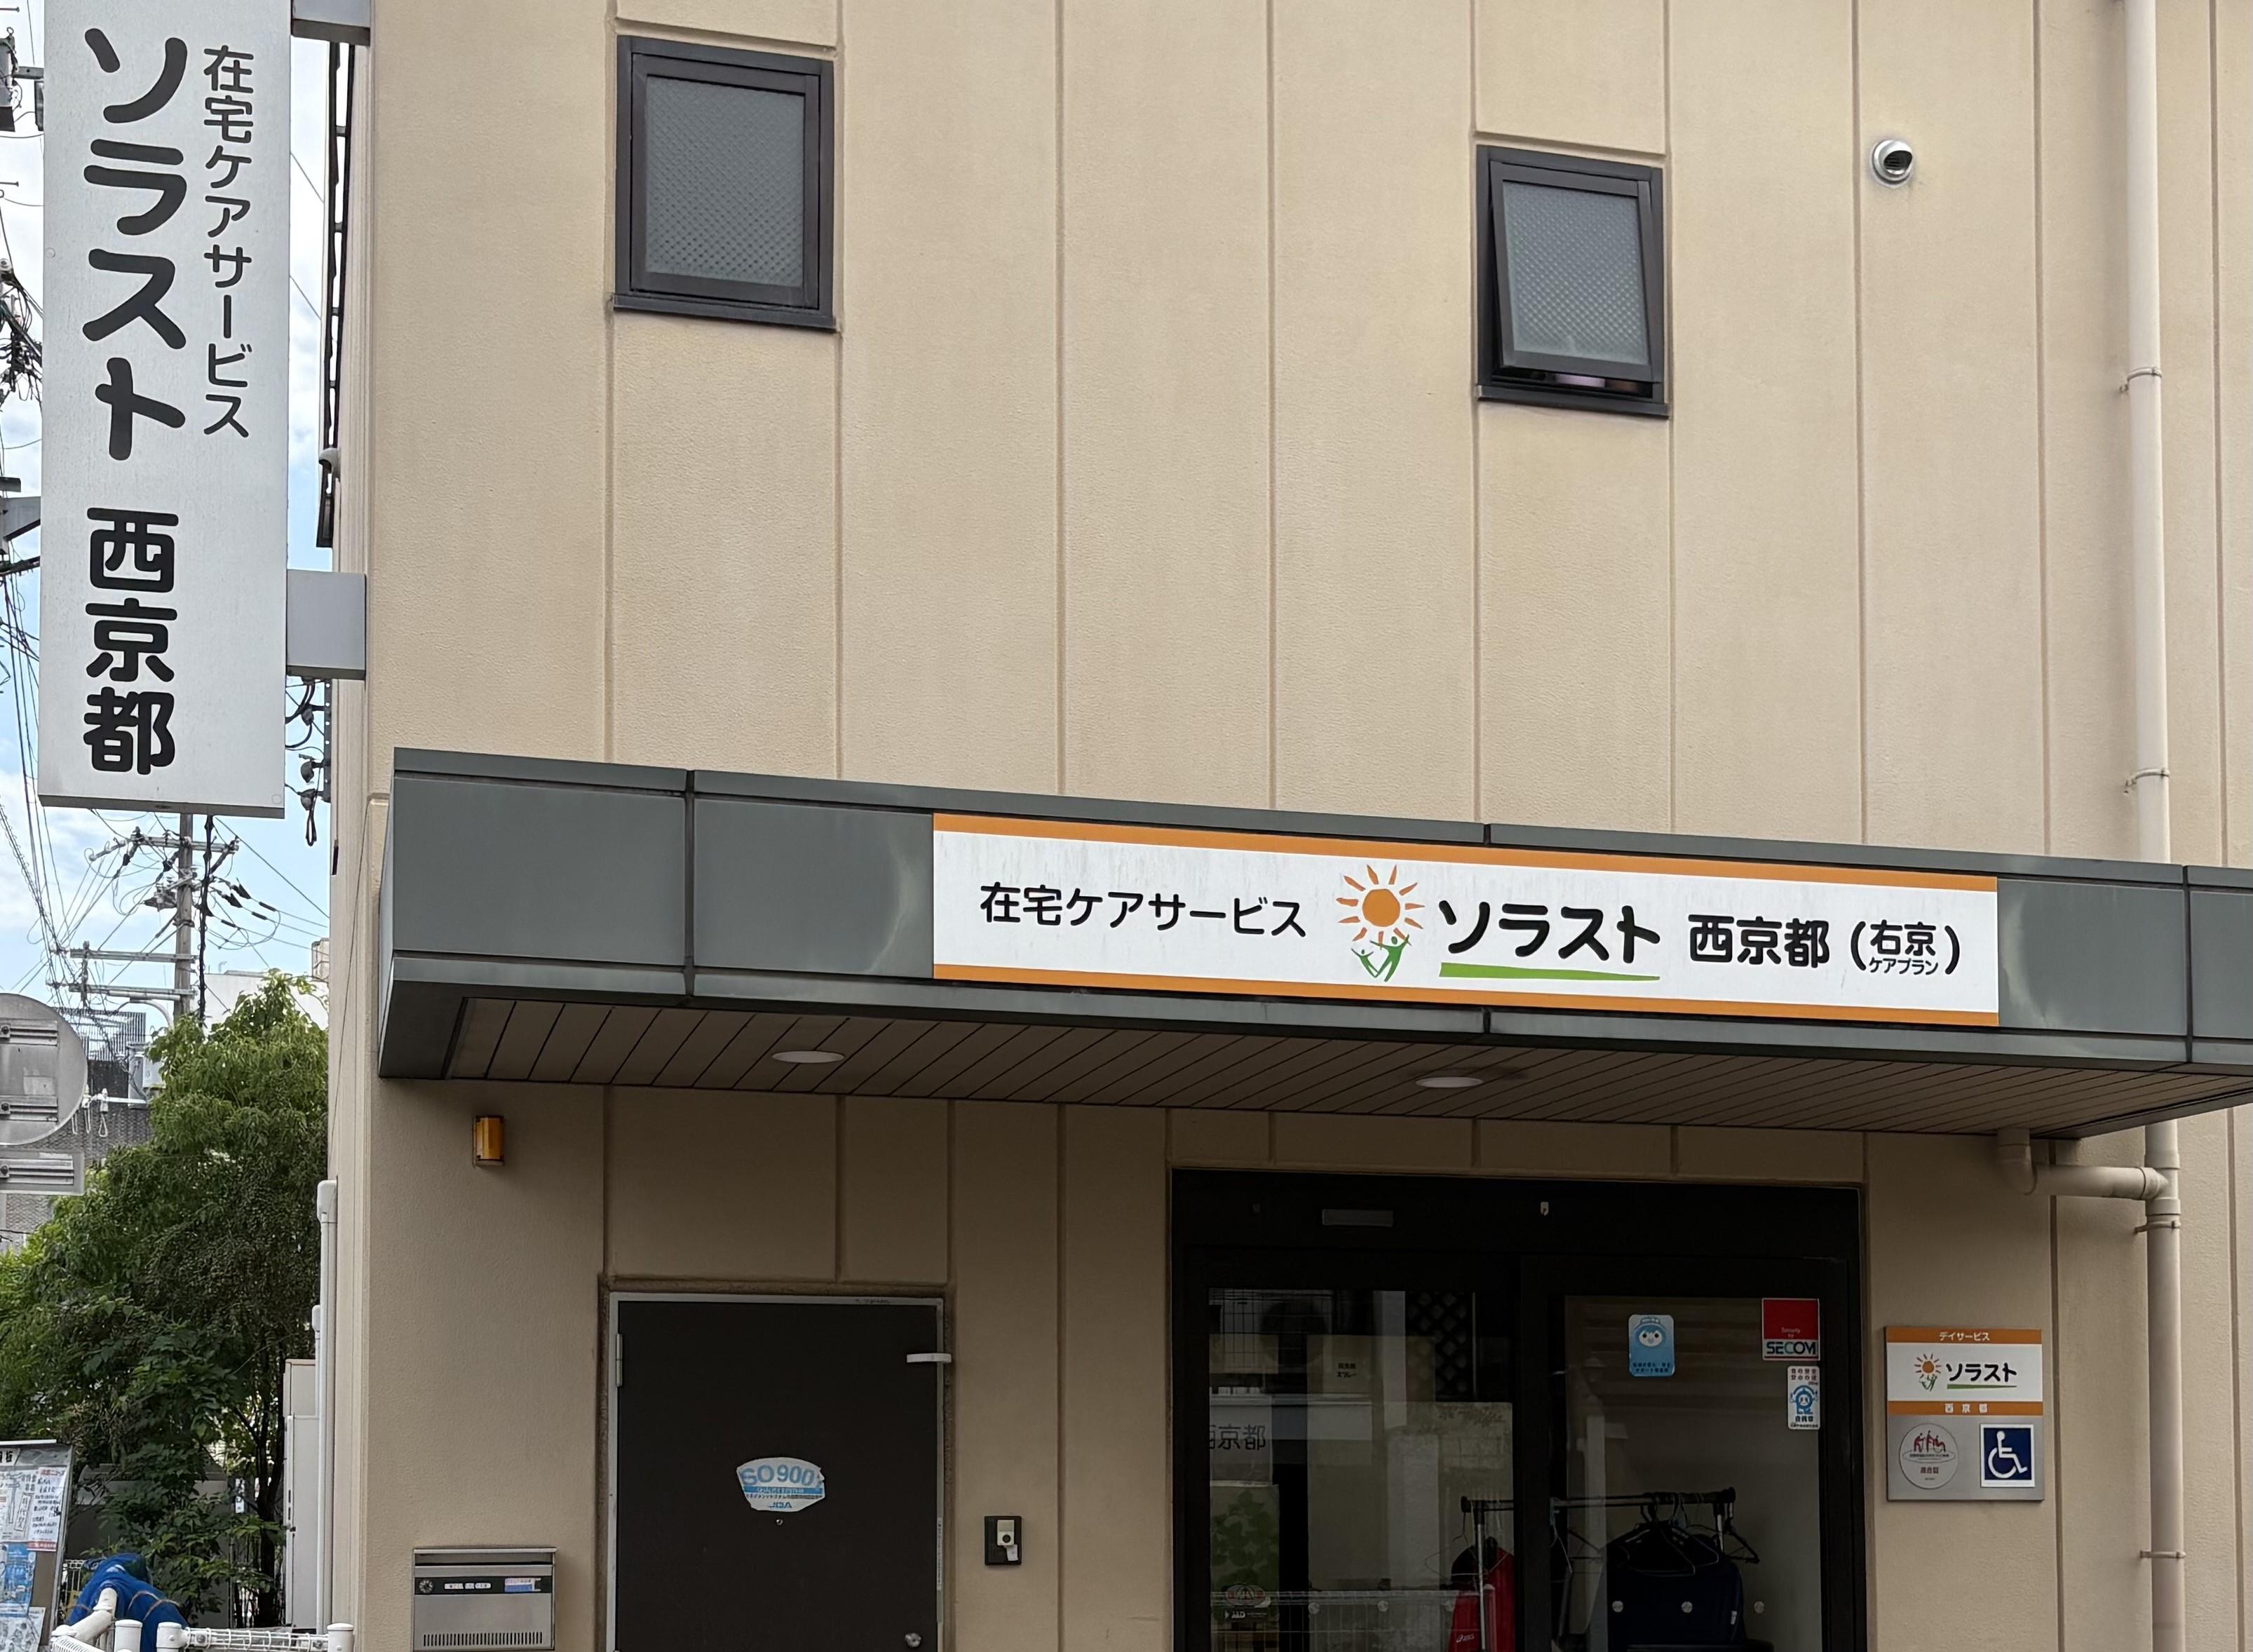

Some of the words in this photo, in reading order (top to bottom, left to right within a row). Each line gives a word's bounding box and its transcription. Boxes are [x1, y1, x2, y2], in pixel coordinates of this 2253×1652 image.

[83, 28, 188, 461] ソラスト
[204, 45, 255, 438] 在宅ケアサービス
[83, 507, 180, 775] 西京都
[980, 881, 1306, 937] 在宅ケアサービス
[1439, 900, 1660, 963] ソラスト
[1688, 914, 1829, 968] 西京都
[1869, 956, 1939, 975] ケアプラン
[1766, 1341, 1816, 1355] SECOM
[1939, 1332, 1991, 1342] デイサービス
[1946, 1362, 2017, 1382] ソラスト
[777, 1464, 823, 1487] 900
